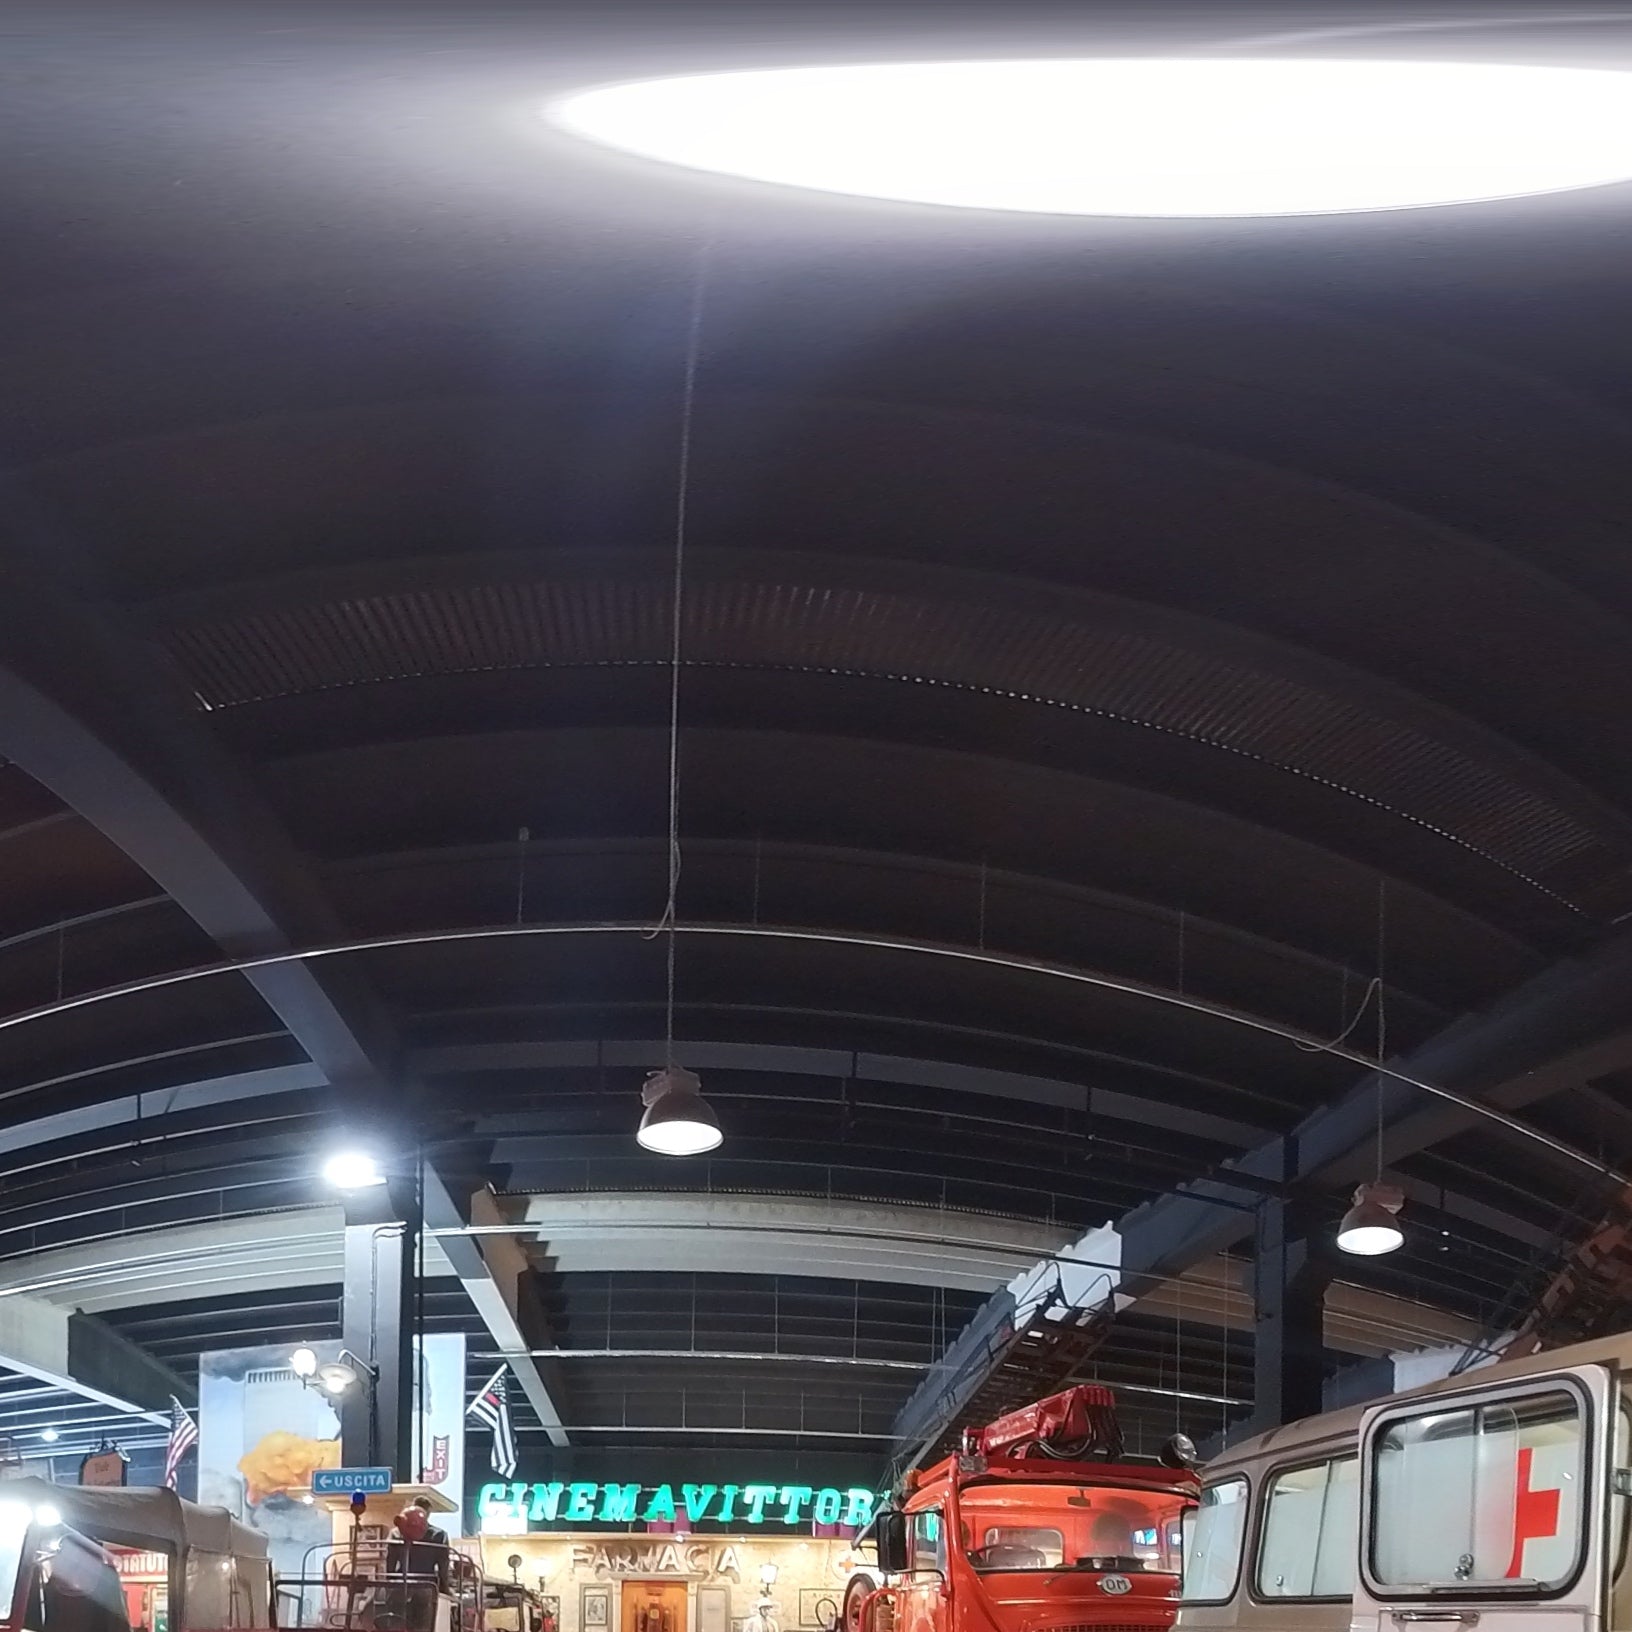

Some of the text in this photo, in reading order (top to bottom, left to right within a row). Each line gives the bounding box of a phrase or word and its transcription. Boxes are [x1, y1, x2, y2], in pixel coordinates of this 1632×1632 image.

[436, 1440, 447, 1480] EXIT
[334, 1475, 386, 1488] USCITA
[1105, 1578, 1128, 1591] OM
